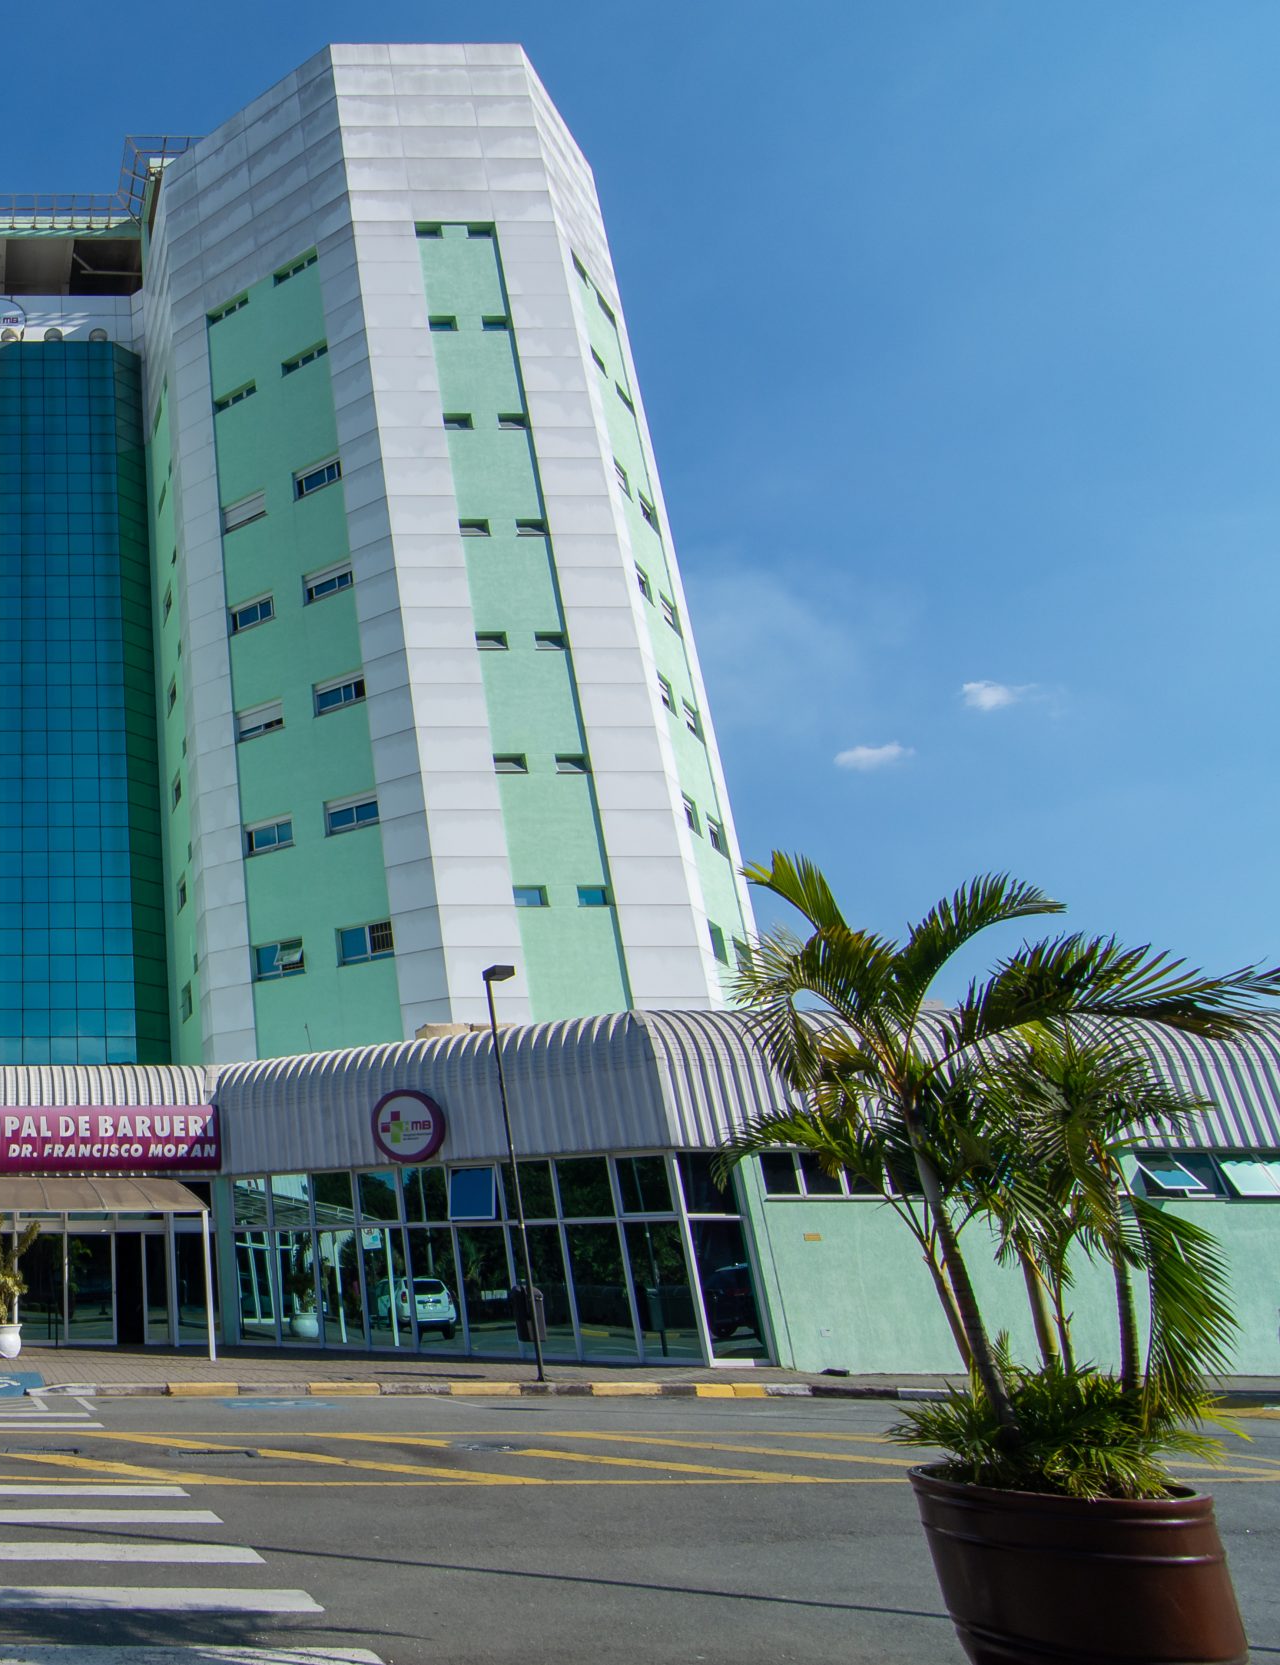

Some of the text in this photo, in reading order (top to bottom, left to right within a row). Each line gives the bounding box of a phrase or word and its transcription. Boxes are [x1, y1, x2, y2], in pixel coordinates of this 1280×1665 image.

[59, 1115, 91, 1137] DE
[98, 1115, 214, 1137] BARUERI
[8, 1143, 217, 1157] DR. FRANCISCO MORAN
